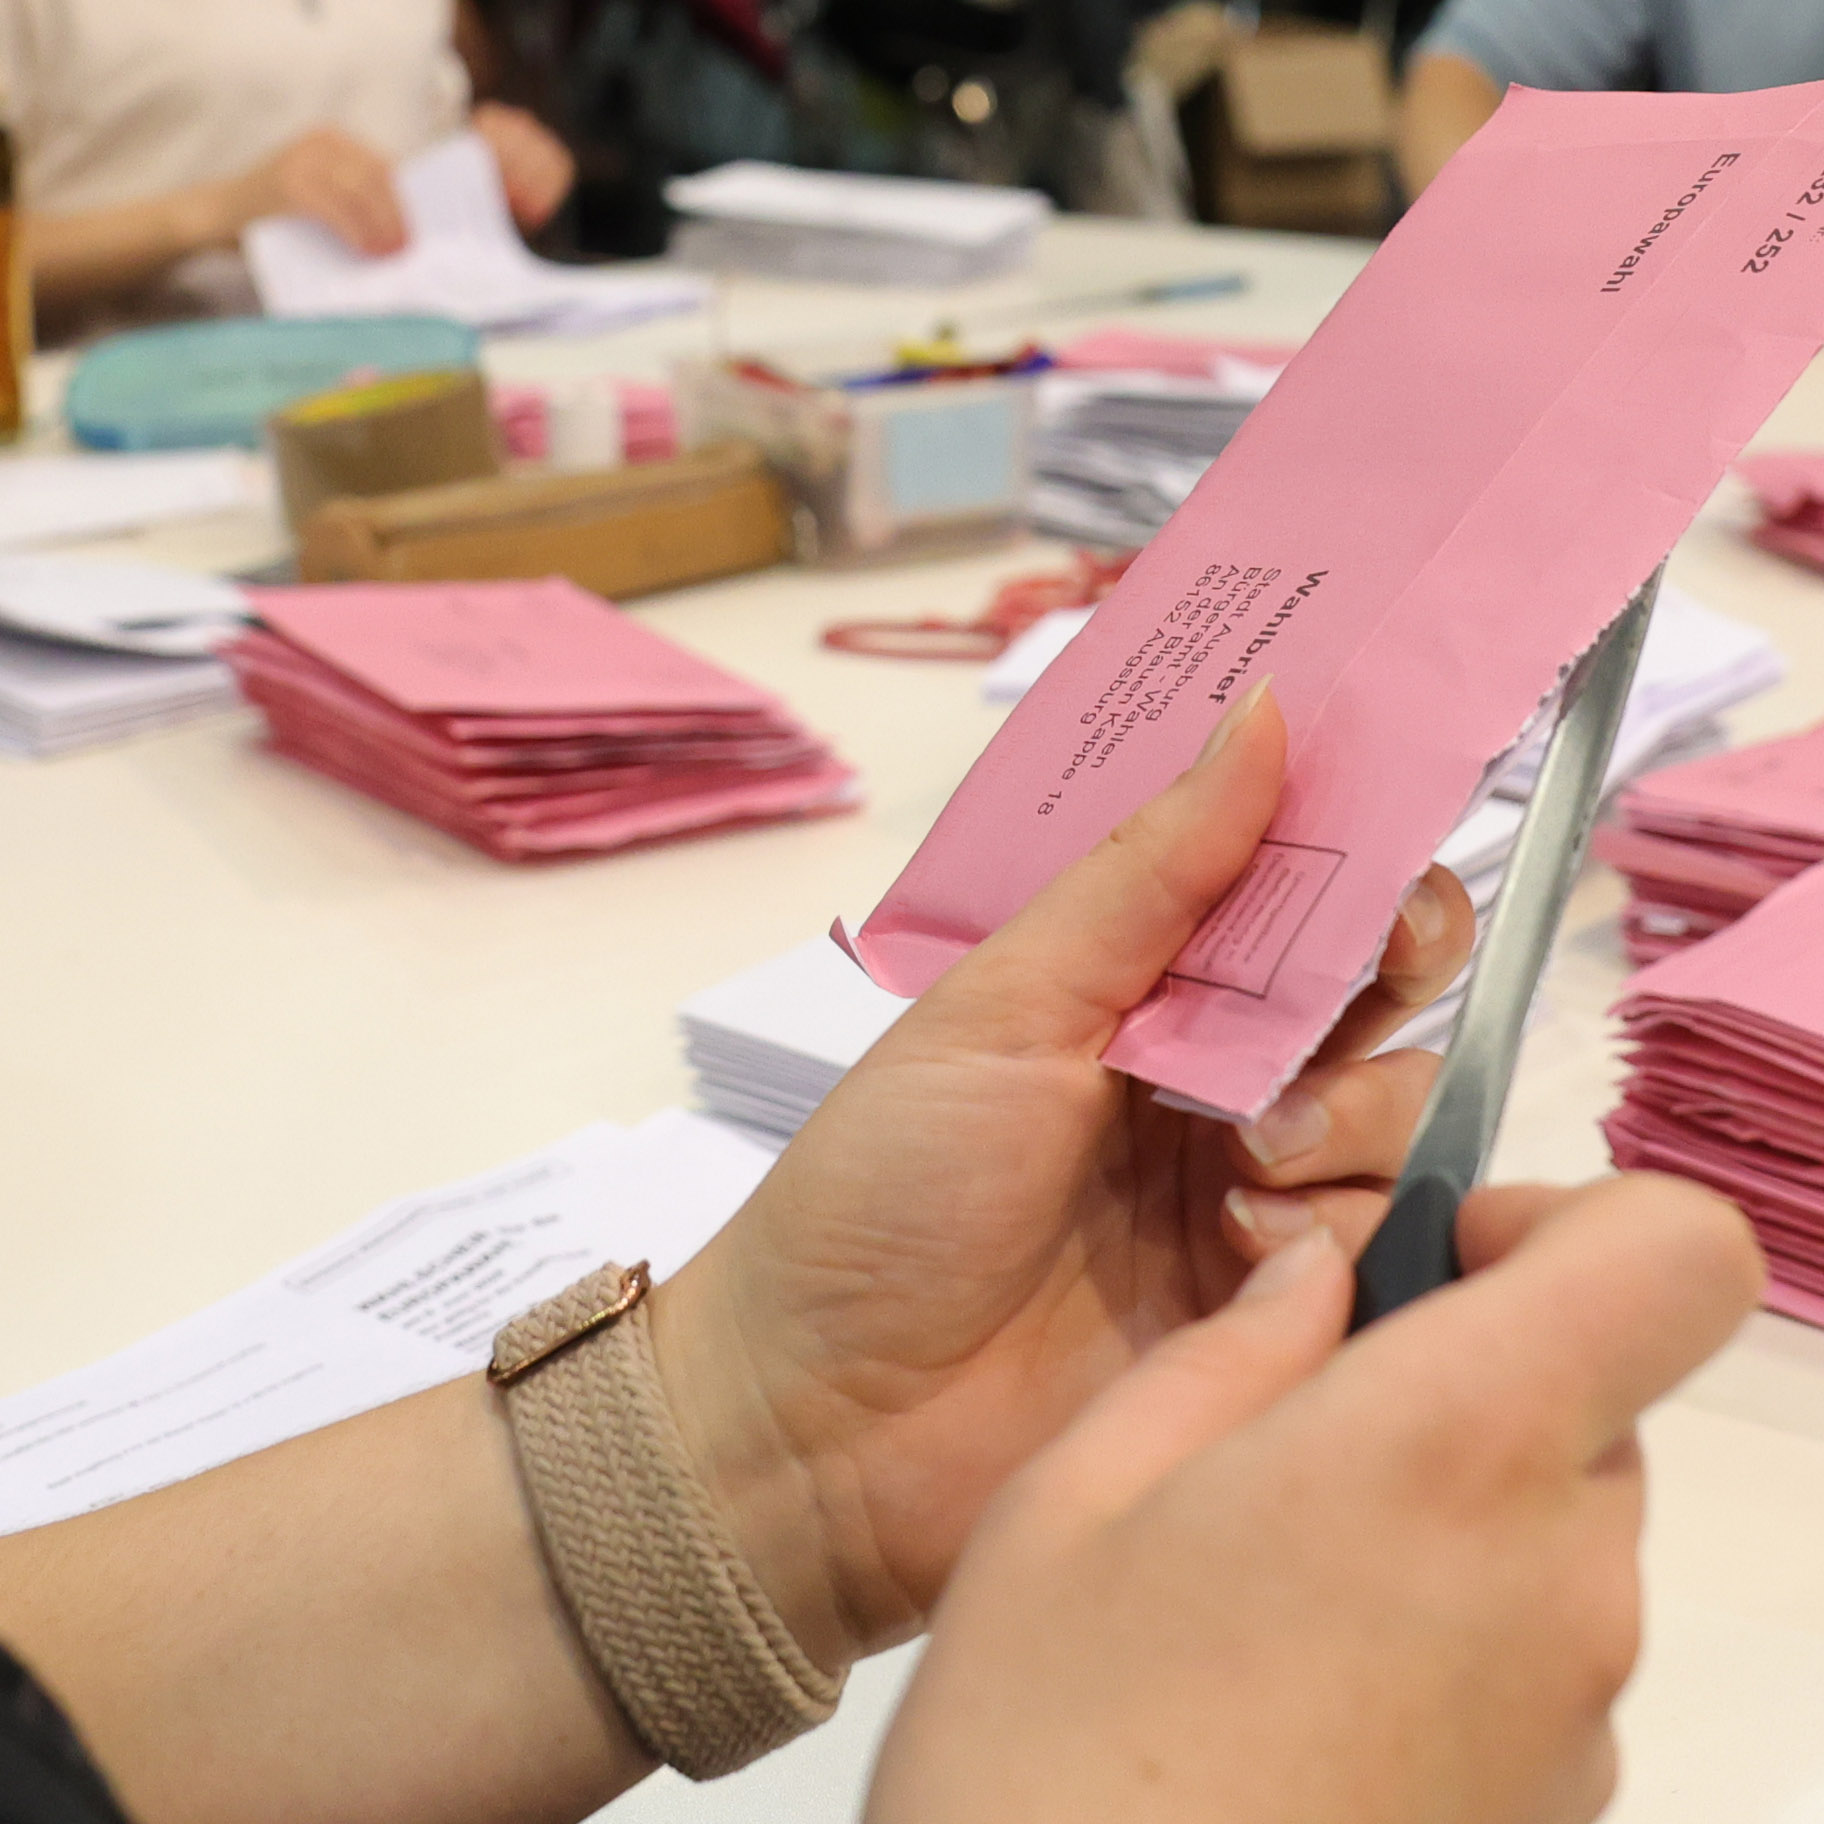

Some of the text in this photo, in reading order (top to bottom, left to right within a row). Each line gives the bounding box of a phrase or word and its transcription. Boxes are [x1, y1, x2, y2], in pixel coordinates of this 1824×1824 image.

[1600, 152, 1741, 292] Europawahl
[1740, 228, 1794, 273] 252
[1080, 564, 1221, 724] 86152 Augsburg
[1145, 567, 1281, 721] Stadt Augsburg
[1167, 567, 1262, 670] Bürgeramt
[1208, 569, 1330, 704] Wahlbrief
[1037, 564, 1240, 816] An der Blauen Kappe 18
[1090, 689, 1162, 768] Wahlen
